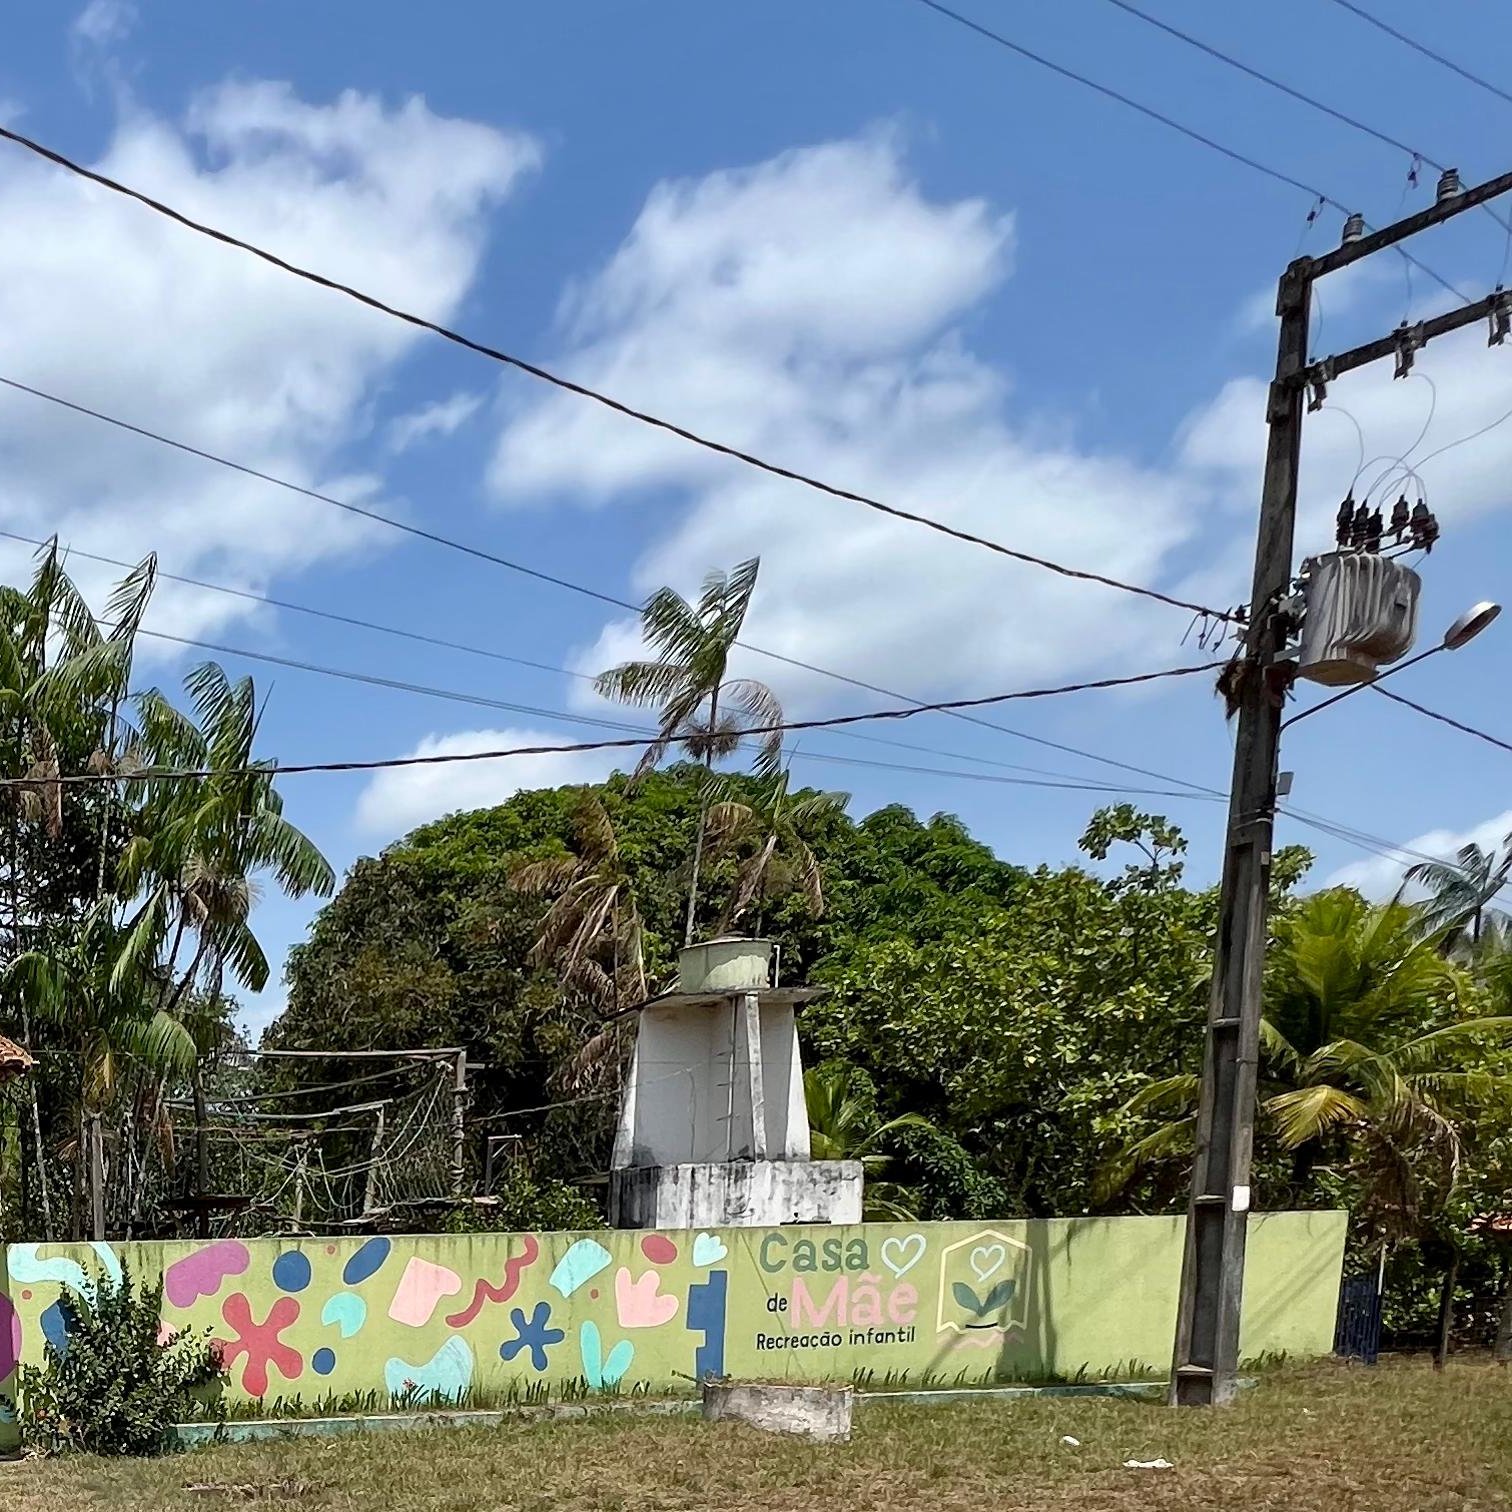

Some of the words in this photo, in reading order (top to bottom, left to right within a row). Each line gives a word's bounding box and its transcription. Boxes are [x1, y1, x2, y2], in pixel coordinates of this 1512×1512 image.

[760, 1233, 870, 1272] Casa
[767, 1292, 787, 1312] de
[791, 1272, 918, 1328] Mãe
[757, 1331, 842, 1350] Recreação
[849, 1326, 915, 1345] infantil
